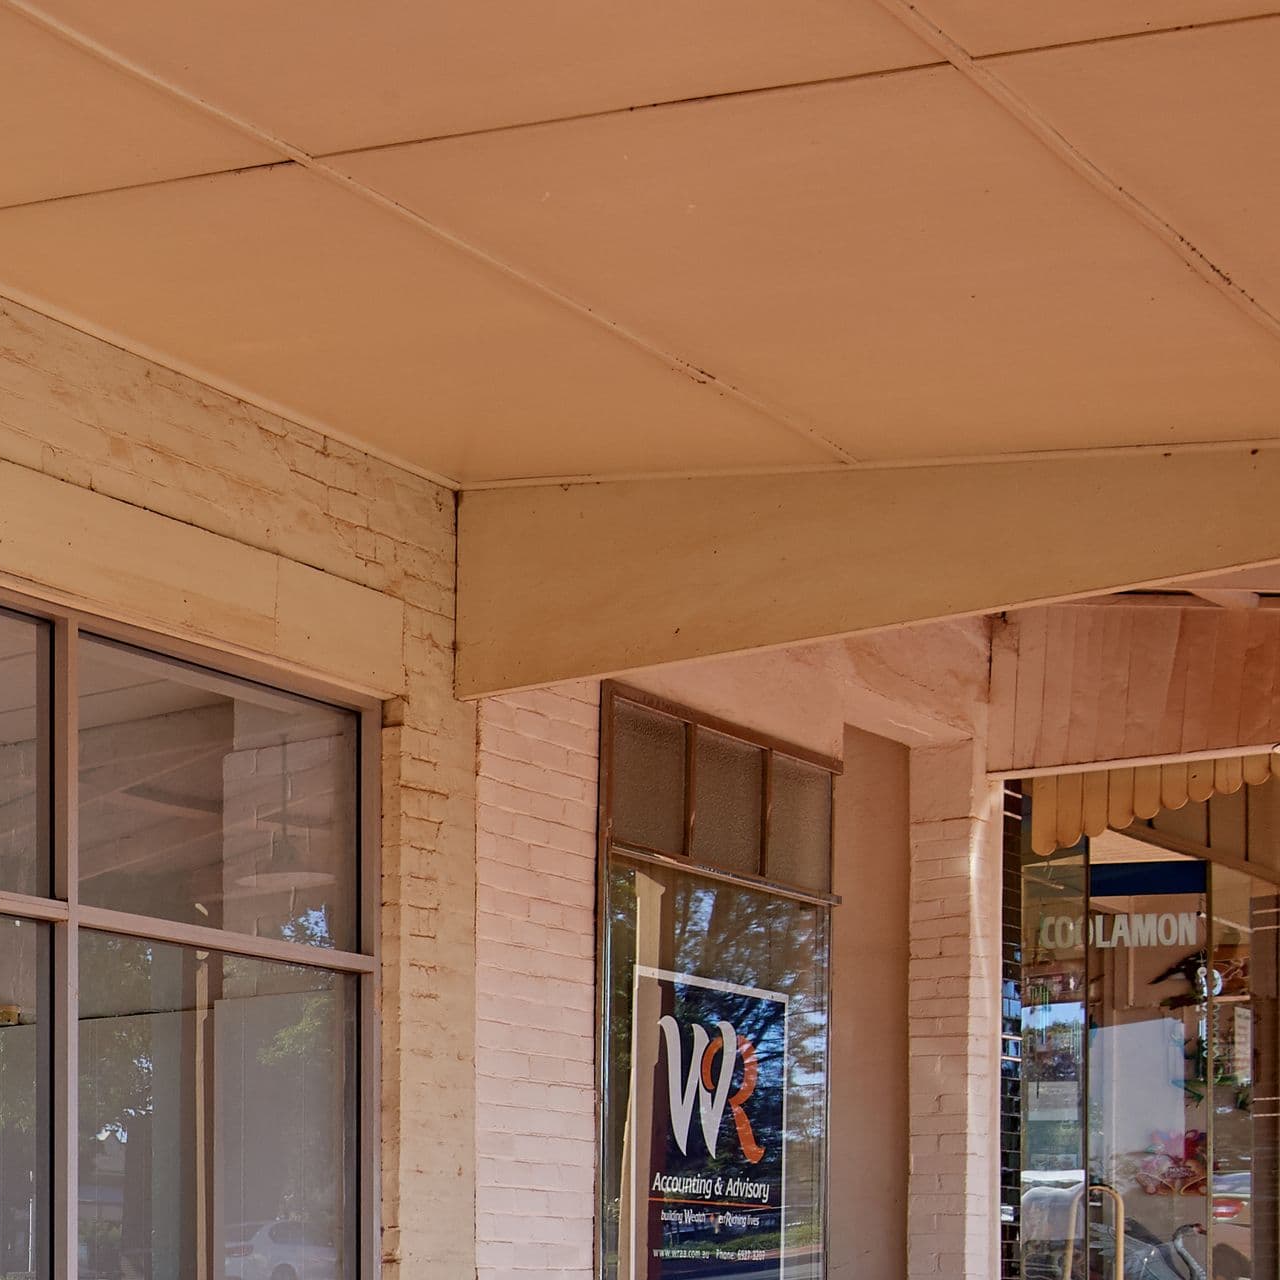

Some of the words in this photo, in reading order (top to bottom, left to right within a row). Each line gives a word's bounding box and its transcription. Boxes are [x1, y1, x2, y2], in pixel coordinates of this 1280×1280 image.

[1040, 912, 1198, 950] COOLAMON
[652, 1172, 713, 1199] Accounting
[714, 1177, 724, 1196] &
[725, 1177, 770, 1203] Advisory
[661, 1209, 683, 1224] building
